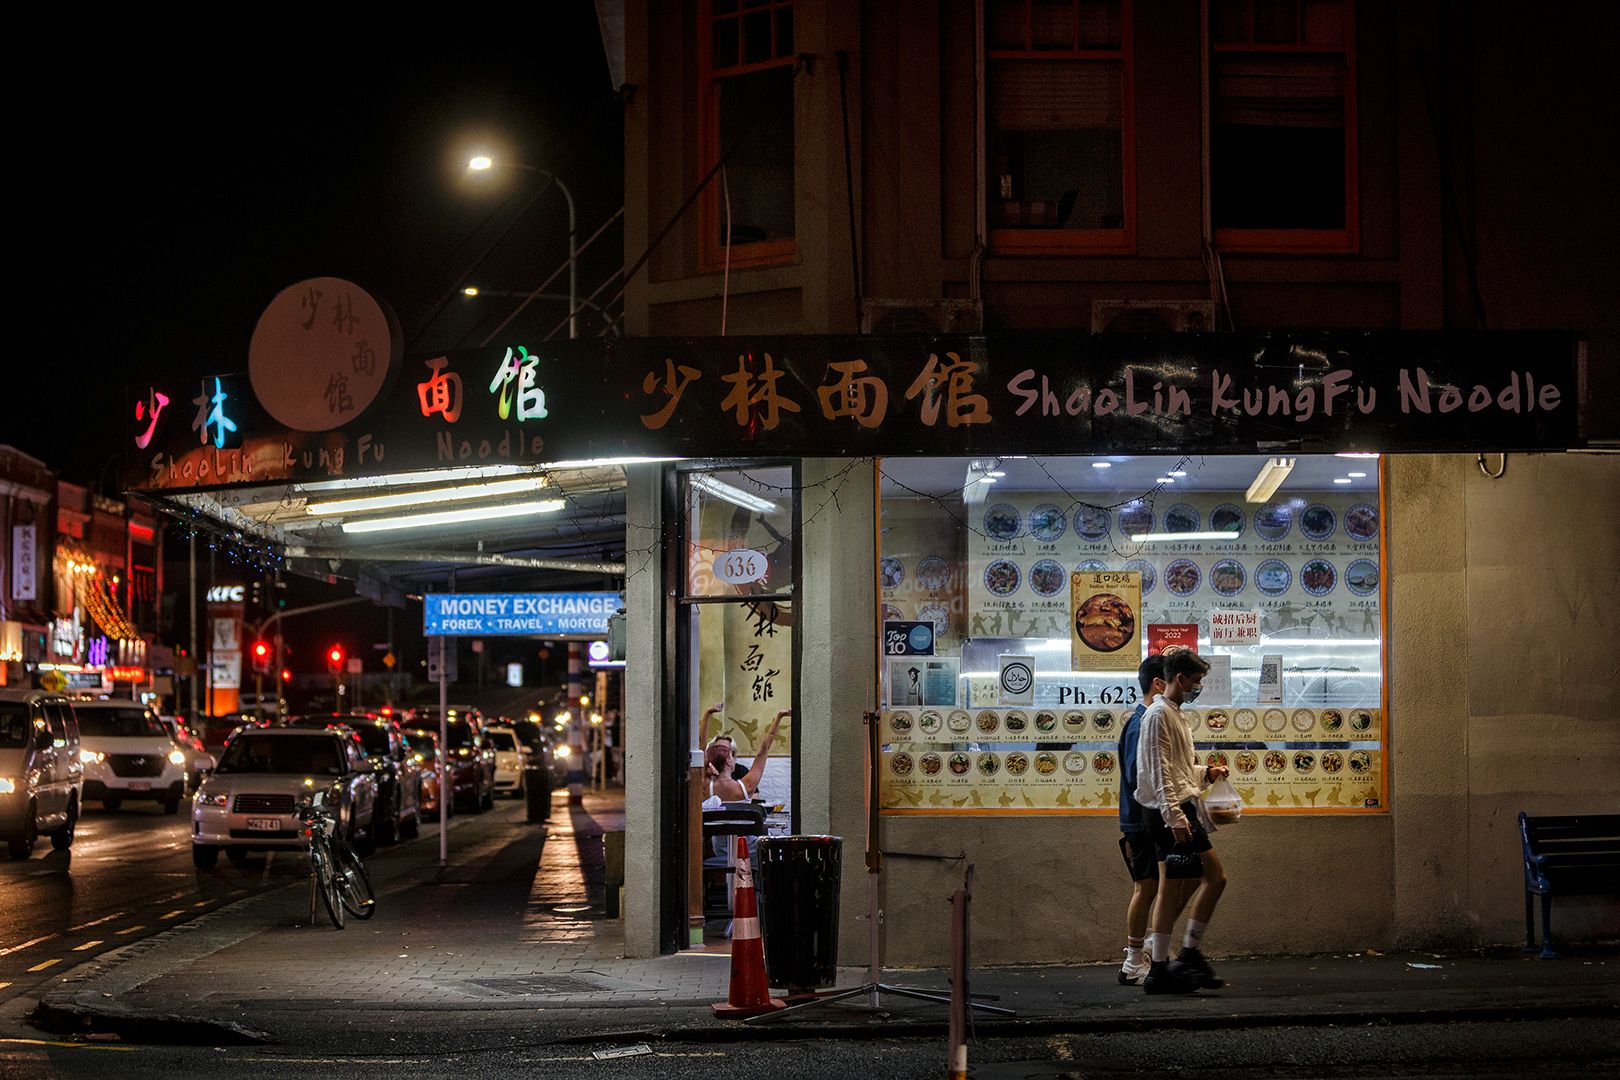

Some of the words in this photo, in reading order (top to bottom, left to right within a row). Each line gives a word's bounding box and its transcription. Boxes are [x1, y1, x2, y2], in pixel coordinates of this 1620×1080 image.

[640, 351, 993, 430] 少林面馆
[1007, 368, 1191, 417] ShaoLin
[1400, 367, 1561, 414] Noodle
[437, 429, 544, 461] Noodle
[724, 555, 756, 578] 636
[206, 586, 245, 602] KFC
[440, 599, 512, 615] MONEY
[513, 598, 615, 615] EXCHANGE
[442, 619, 482, 630] FOREX
[497, 618, 543, 629] TRAVEL
[1212, 613, 1257, 625] 诚招后厨
[887, 630, 907, 642] Top
[1213, 627, 1258, 639] 前厅兼职
[888, 641, 906, 655] 10
[1058, 686, 1092, 705] Ph.
[1101, 686, 1137, 705] 623
